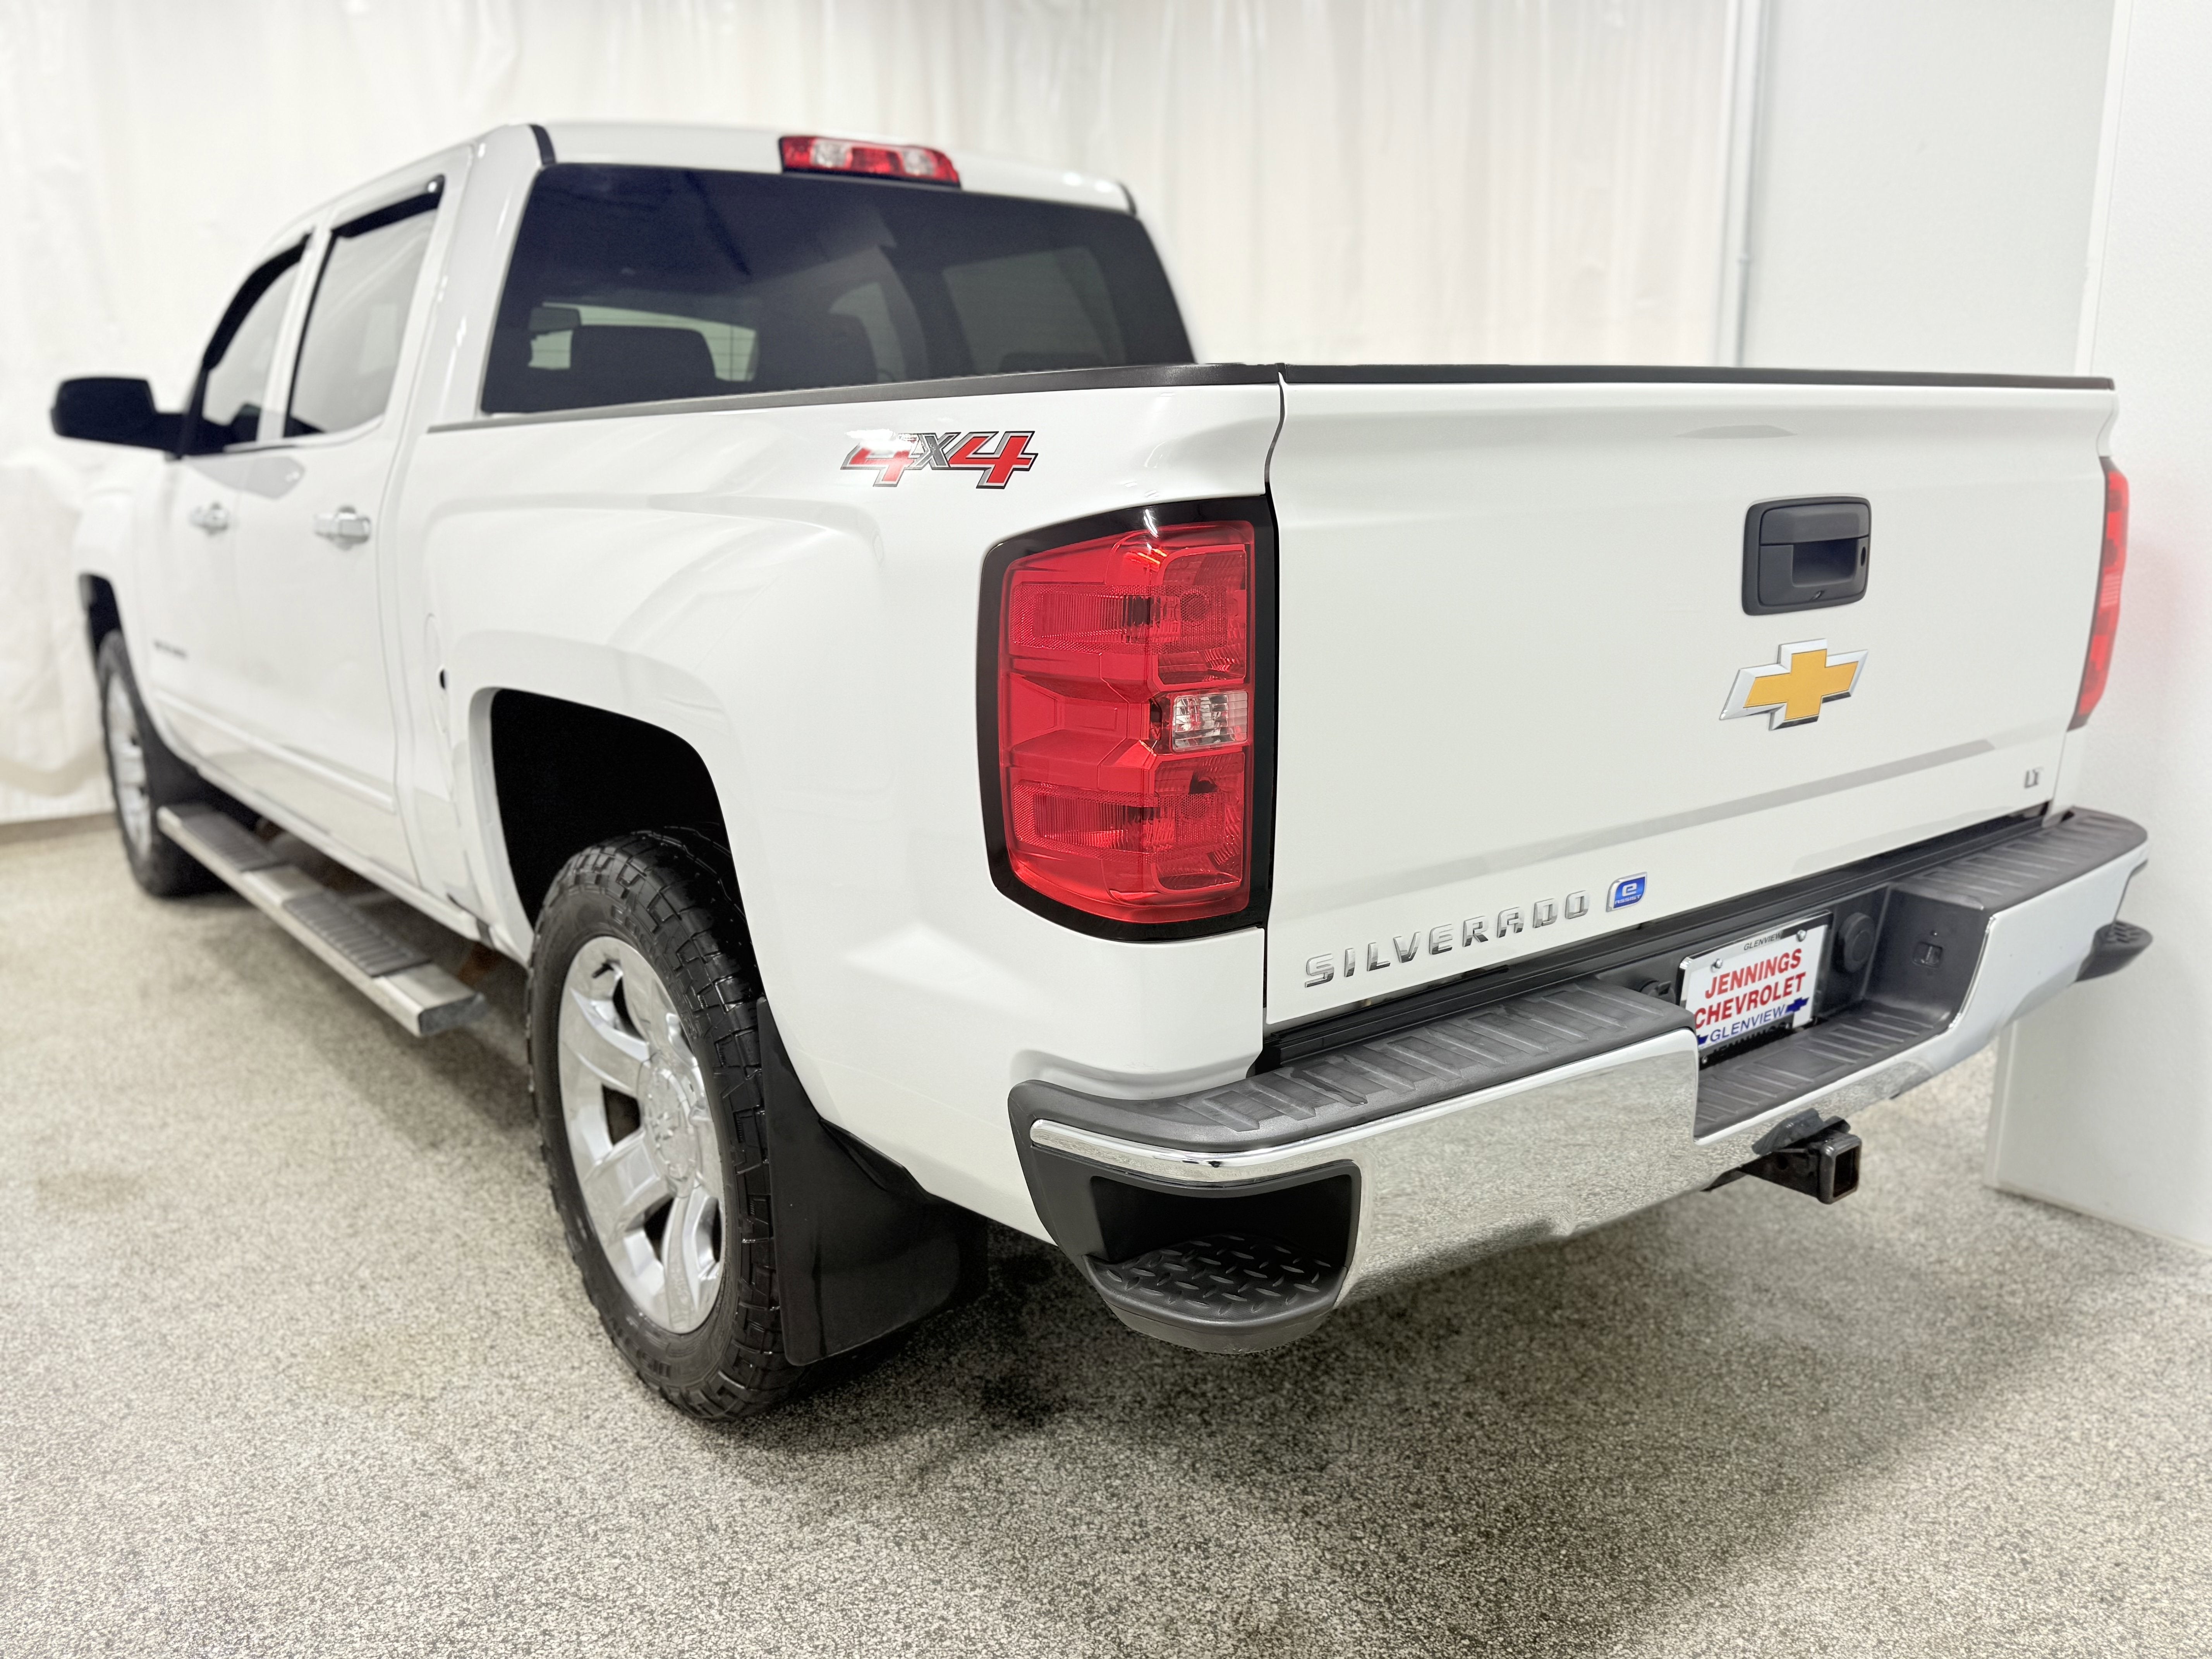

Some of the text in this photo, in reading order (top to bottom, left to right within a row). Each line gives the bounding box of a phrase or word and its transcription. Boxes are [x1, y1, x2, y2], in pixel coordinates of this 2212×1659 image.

[1304, 890, 1590, 988] SILVERADO
[1744, 931, 1782, 950] GLENVIEW
[1705, 948, 1802, 999] JENNINGS
[1694, 971, 1807, 1029] CHEVROLET
[1710, 1004, 1786, 1042] GLENVIEW
